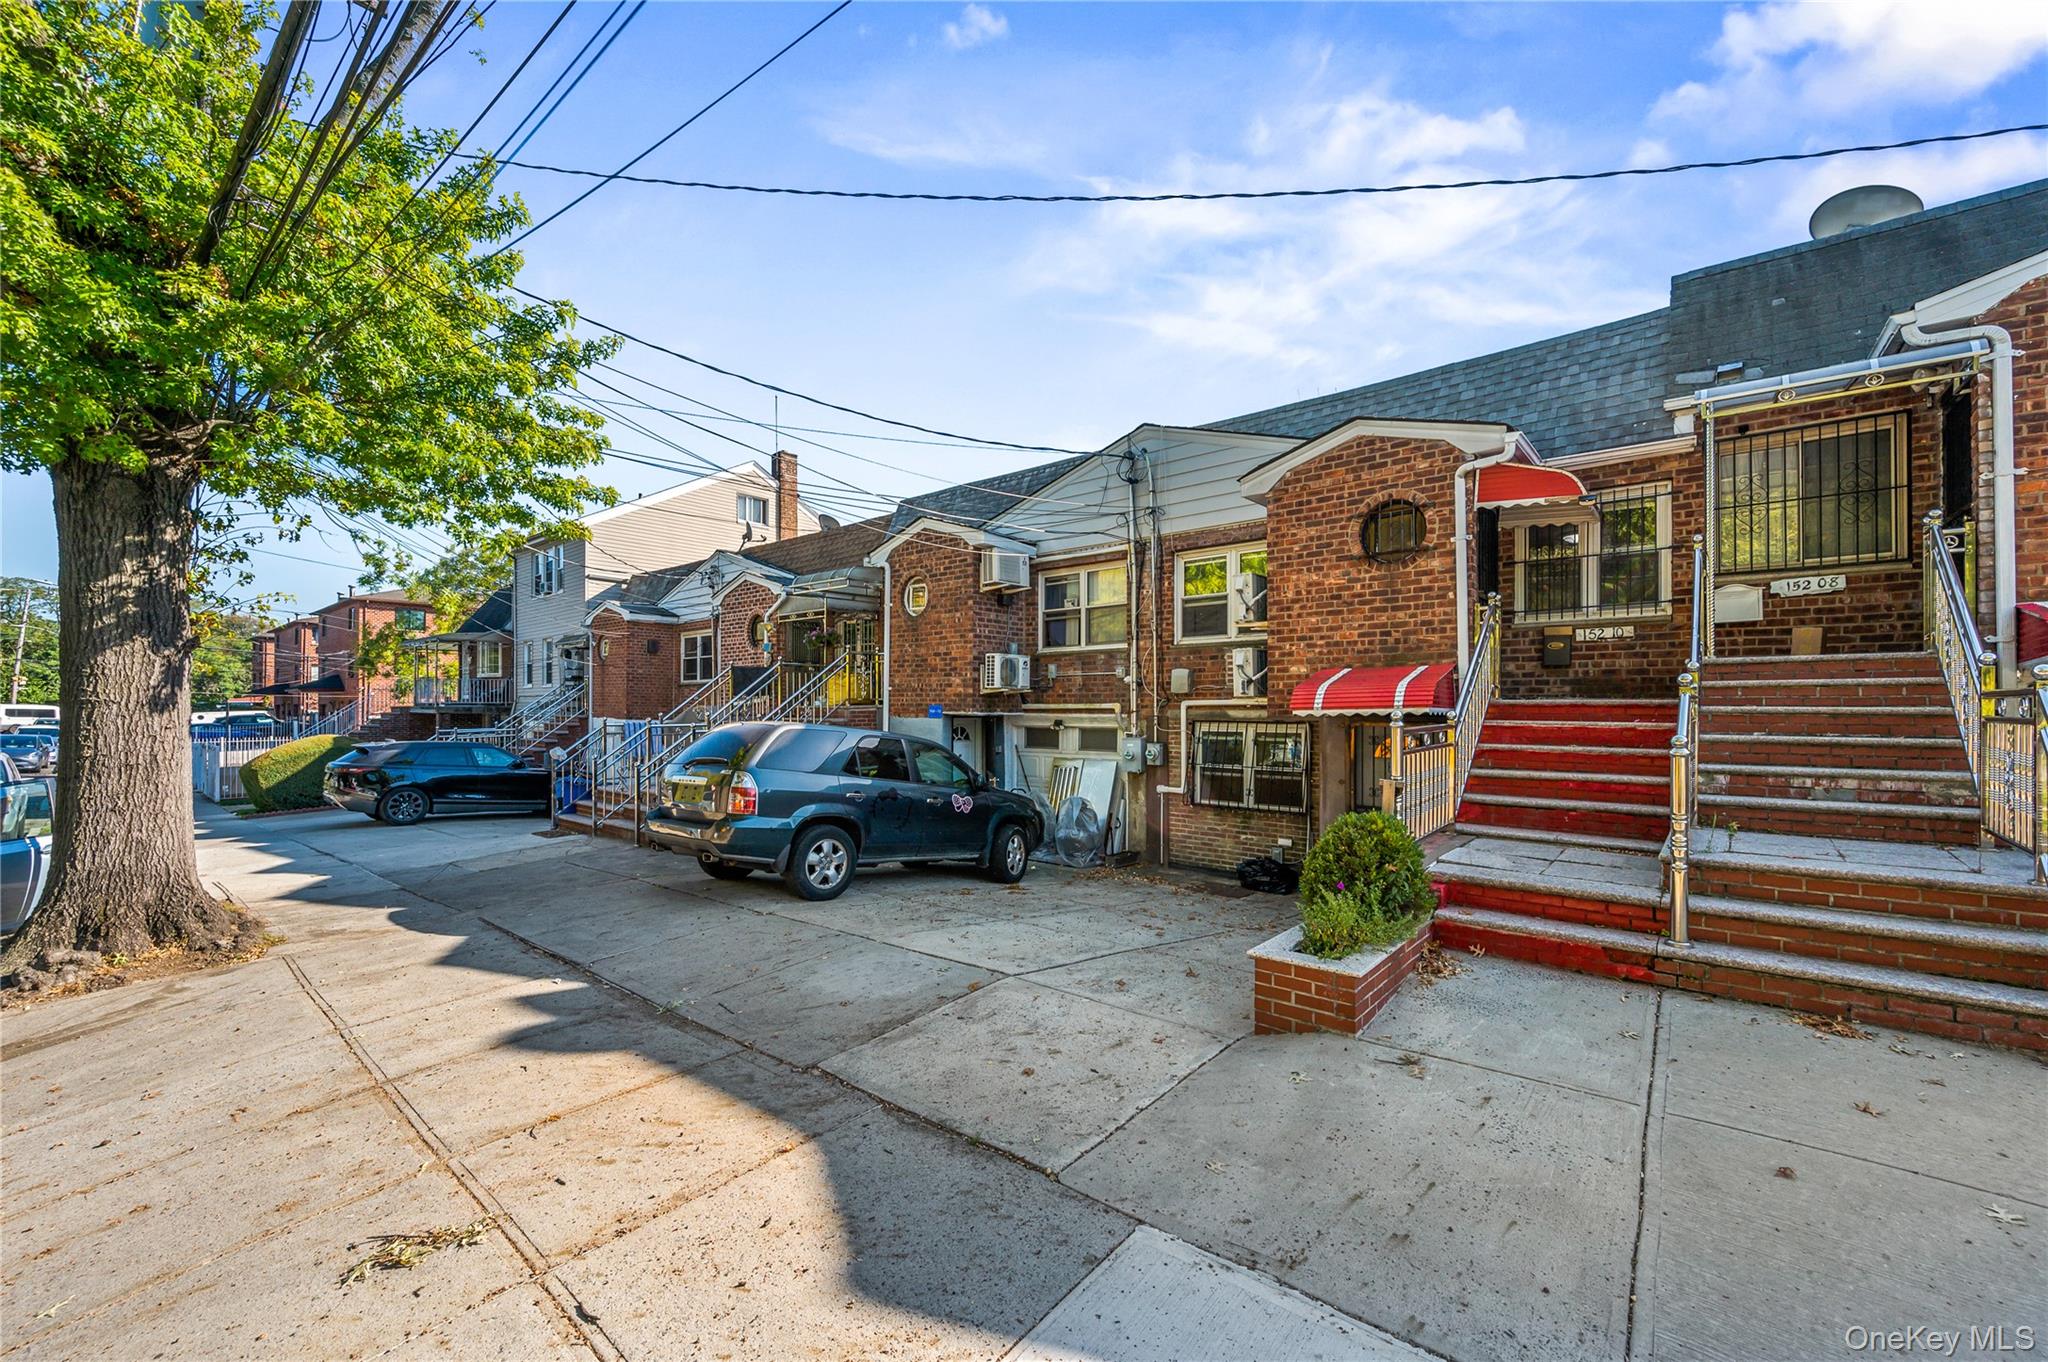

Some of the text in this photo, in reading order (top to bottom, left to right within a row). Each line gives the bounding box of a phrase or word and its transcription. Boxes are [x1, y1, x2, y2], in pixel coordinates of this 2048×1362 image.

[1786, 579, 1811, 592] 152
[1583, 626, 1624, 640] 152 10
